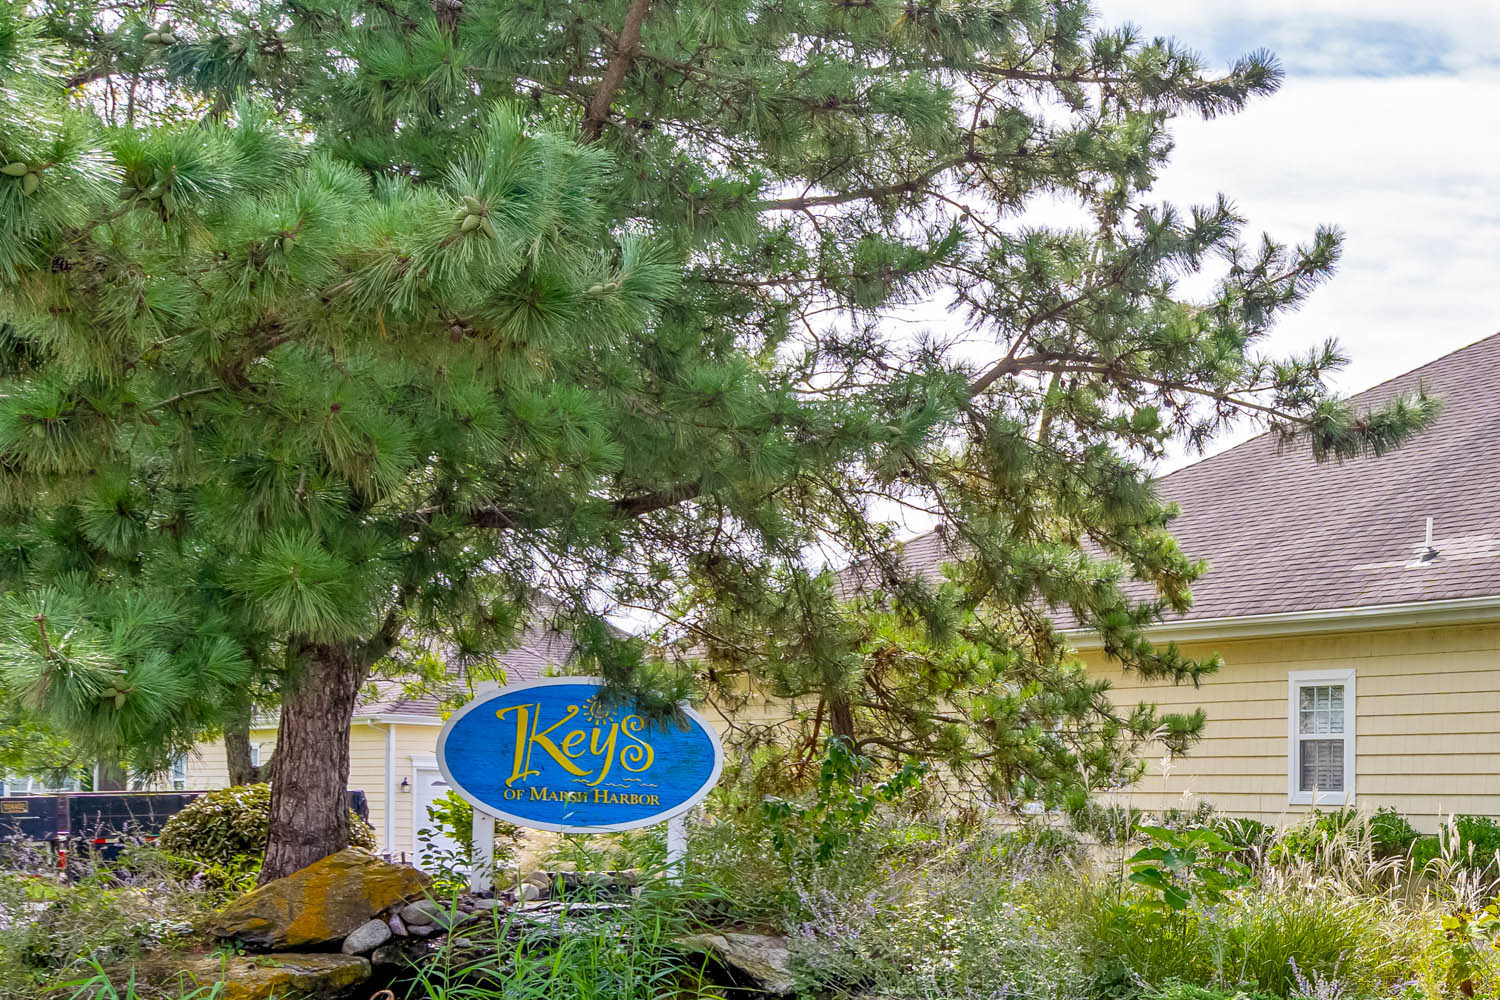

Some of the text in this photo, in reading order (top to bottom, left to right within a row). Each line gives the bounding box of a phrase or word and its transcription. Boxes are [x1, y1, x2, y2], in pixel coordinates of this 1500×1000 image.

[496, 703, 654, 787] Keys
[503, 788, 525, 801] OF
[594, 789, 660, 806] HARBOR
